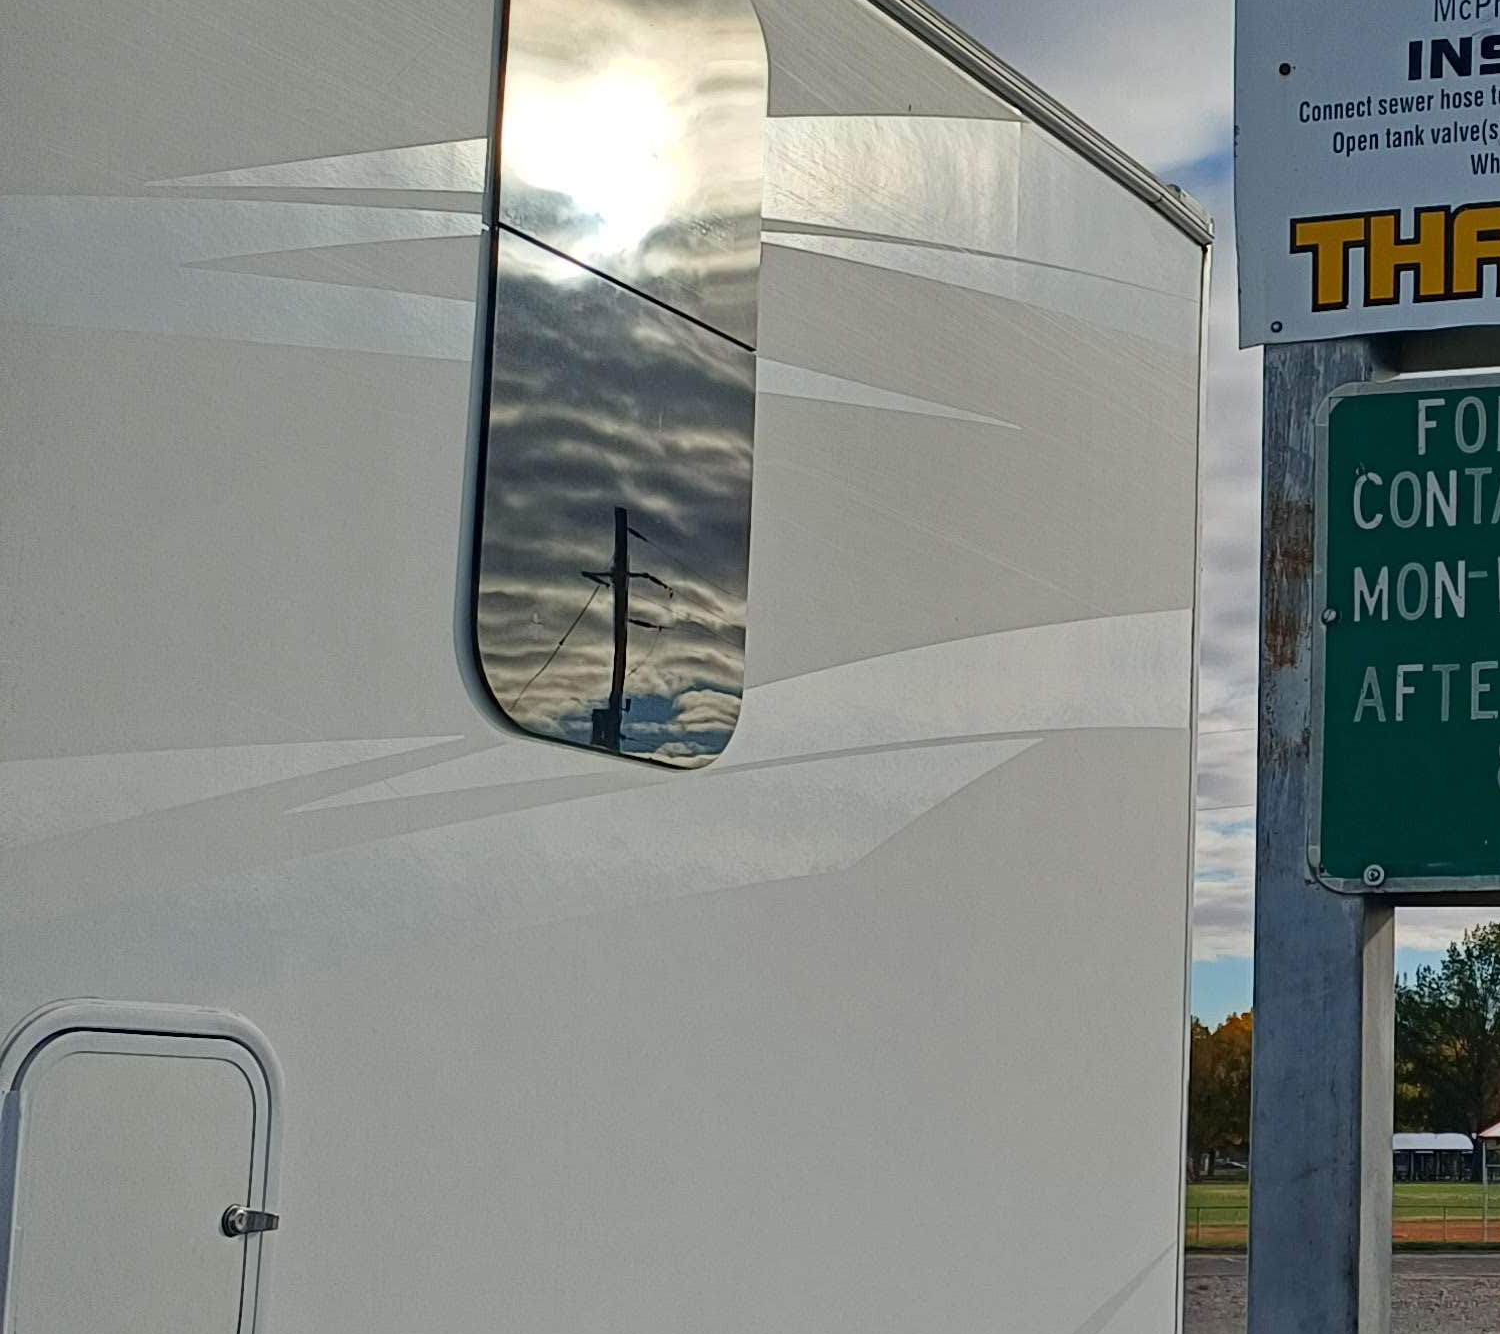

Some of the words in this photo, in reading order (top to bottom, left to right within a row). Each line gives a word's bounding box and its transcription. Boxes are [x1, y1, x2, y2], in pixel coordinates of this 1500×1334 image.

[1300, 96, 1372, 123] Connect
[1378, 94, 1434, 114] sewer
[1440, 86, 1484, 110] hose
[1333, 132, 1379, 157] Open
[1386, 125, 1424, 149] tank
